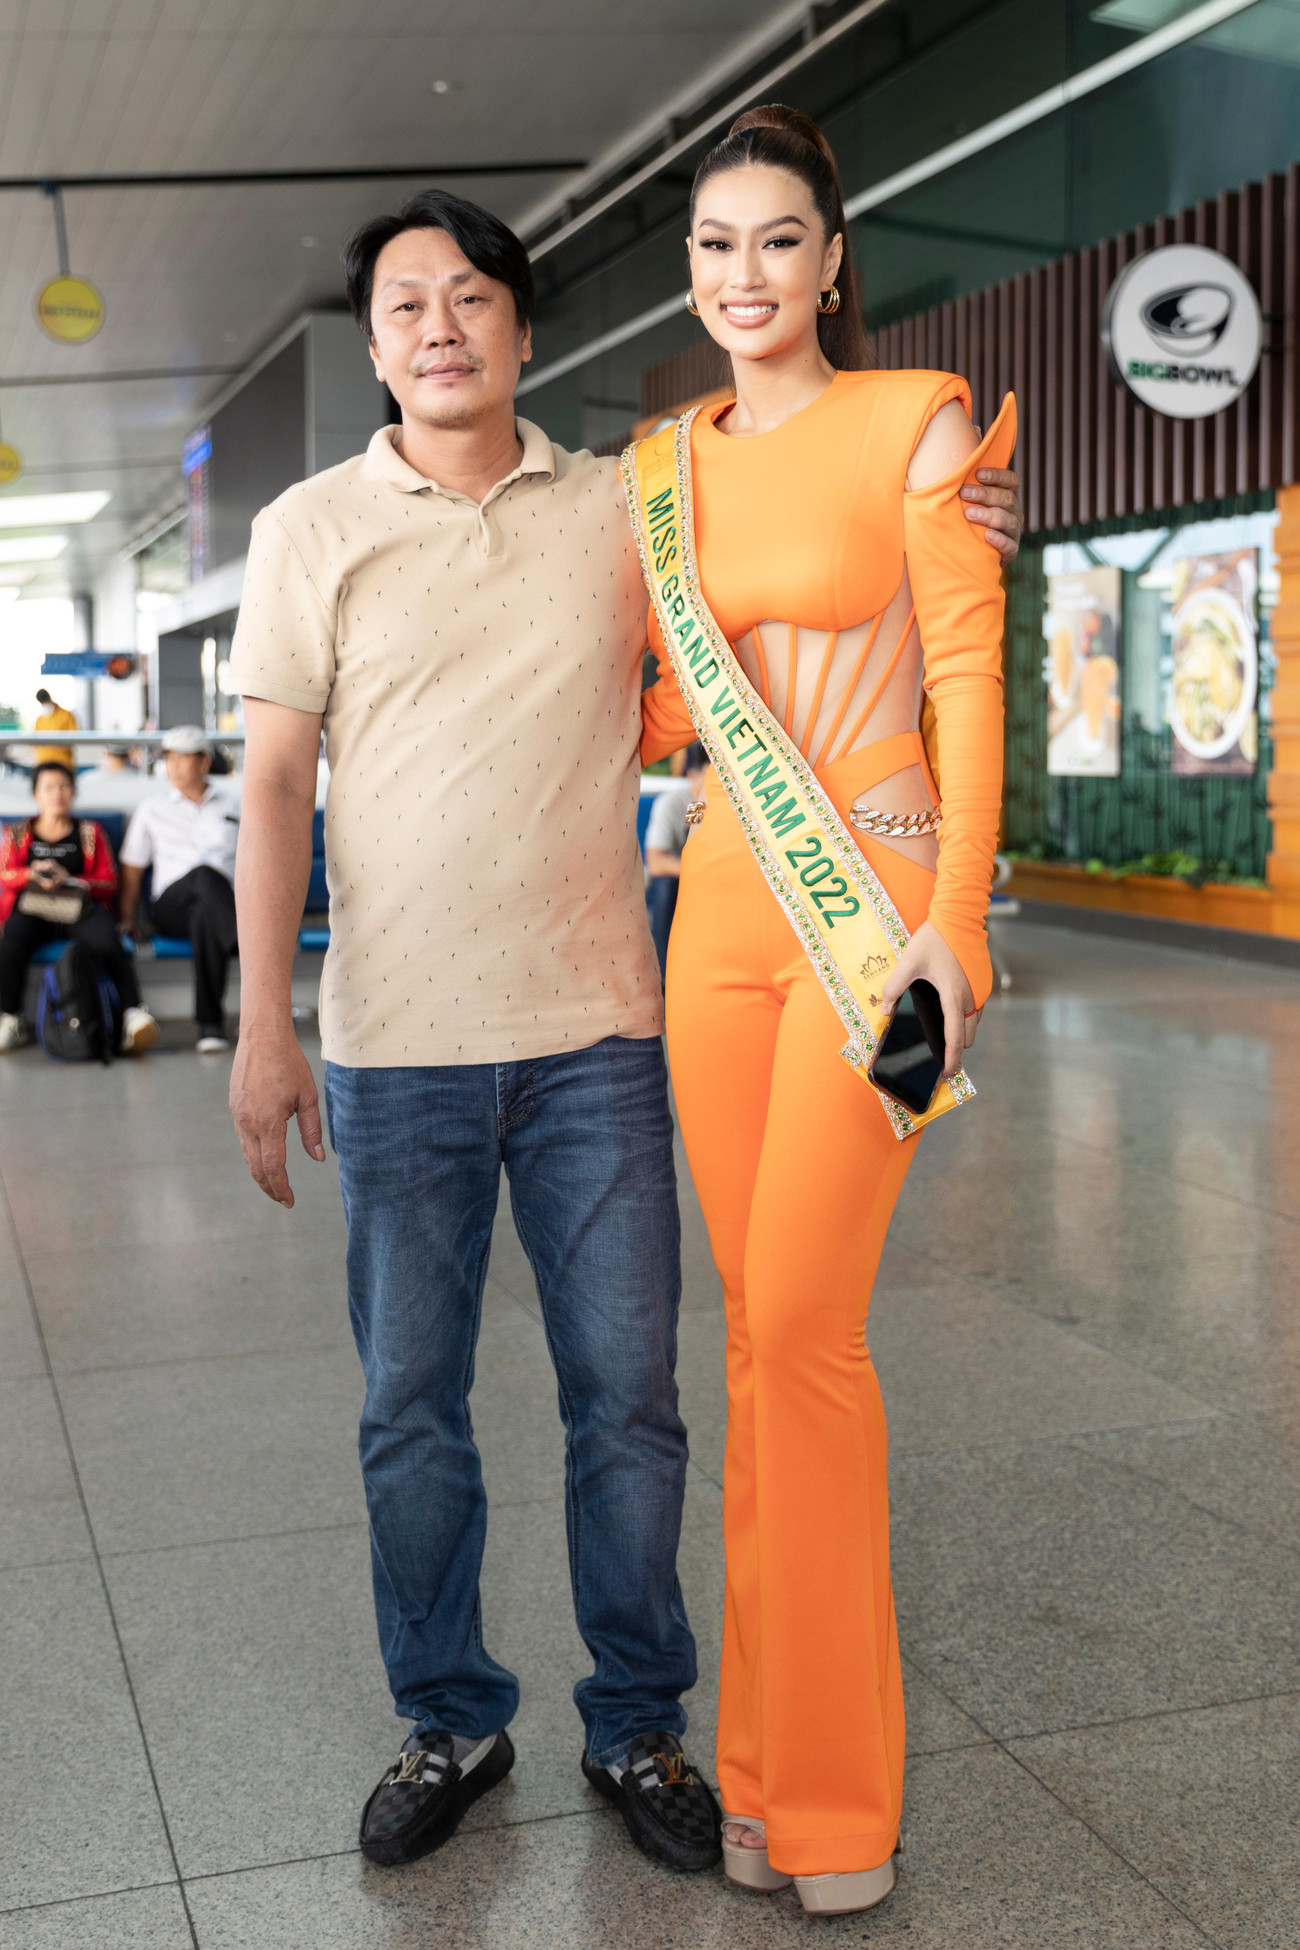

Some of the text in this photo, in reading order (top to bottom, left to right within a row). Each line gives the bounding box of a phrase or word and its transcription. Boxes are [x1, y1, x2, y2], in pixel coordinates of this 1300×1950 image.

[646, 487, 677, 573] MISS
[661, 573, 720, 689] GRAND
[710, 685, 807, 839] VIETNAM
[784, 836, 860, 929] 2022
